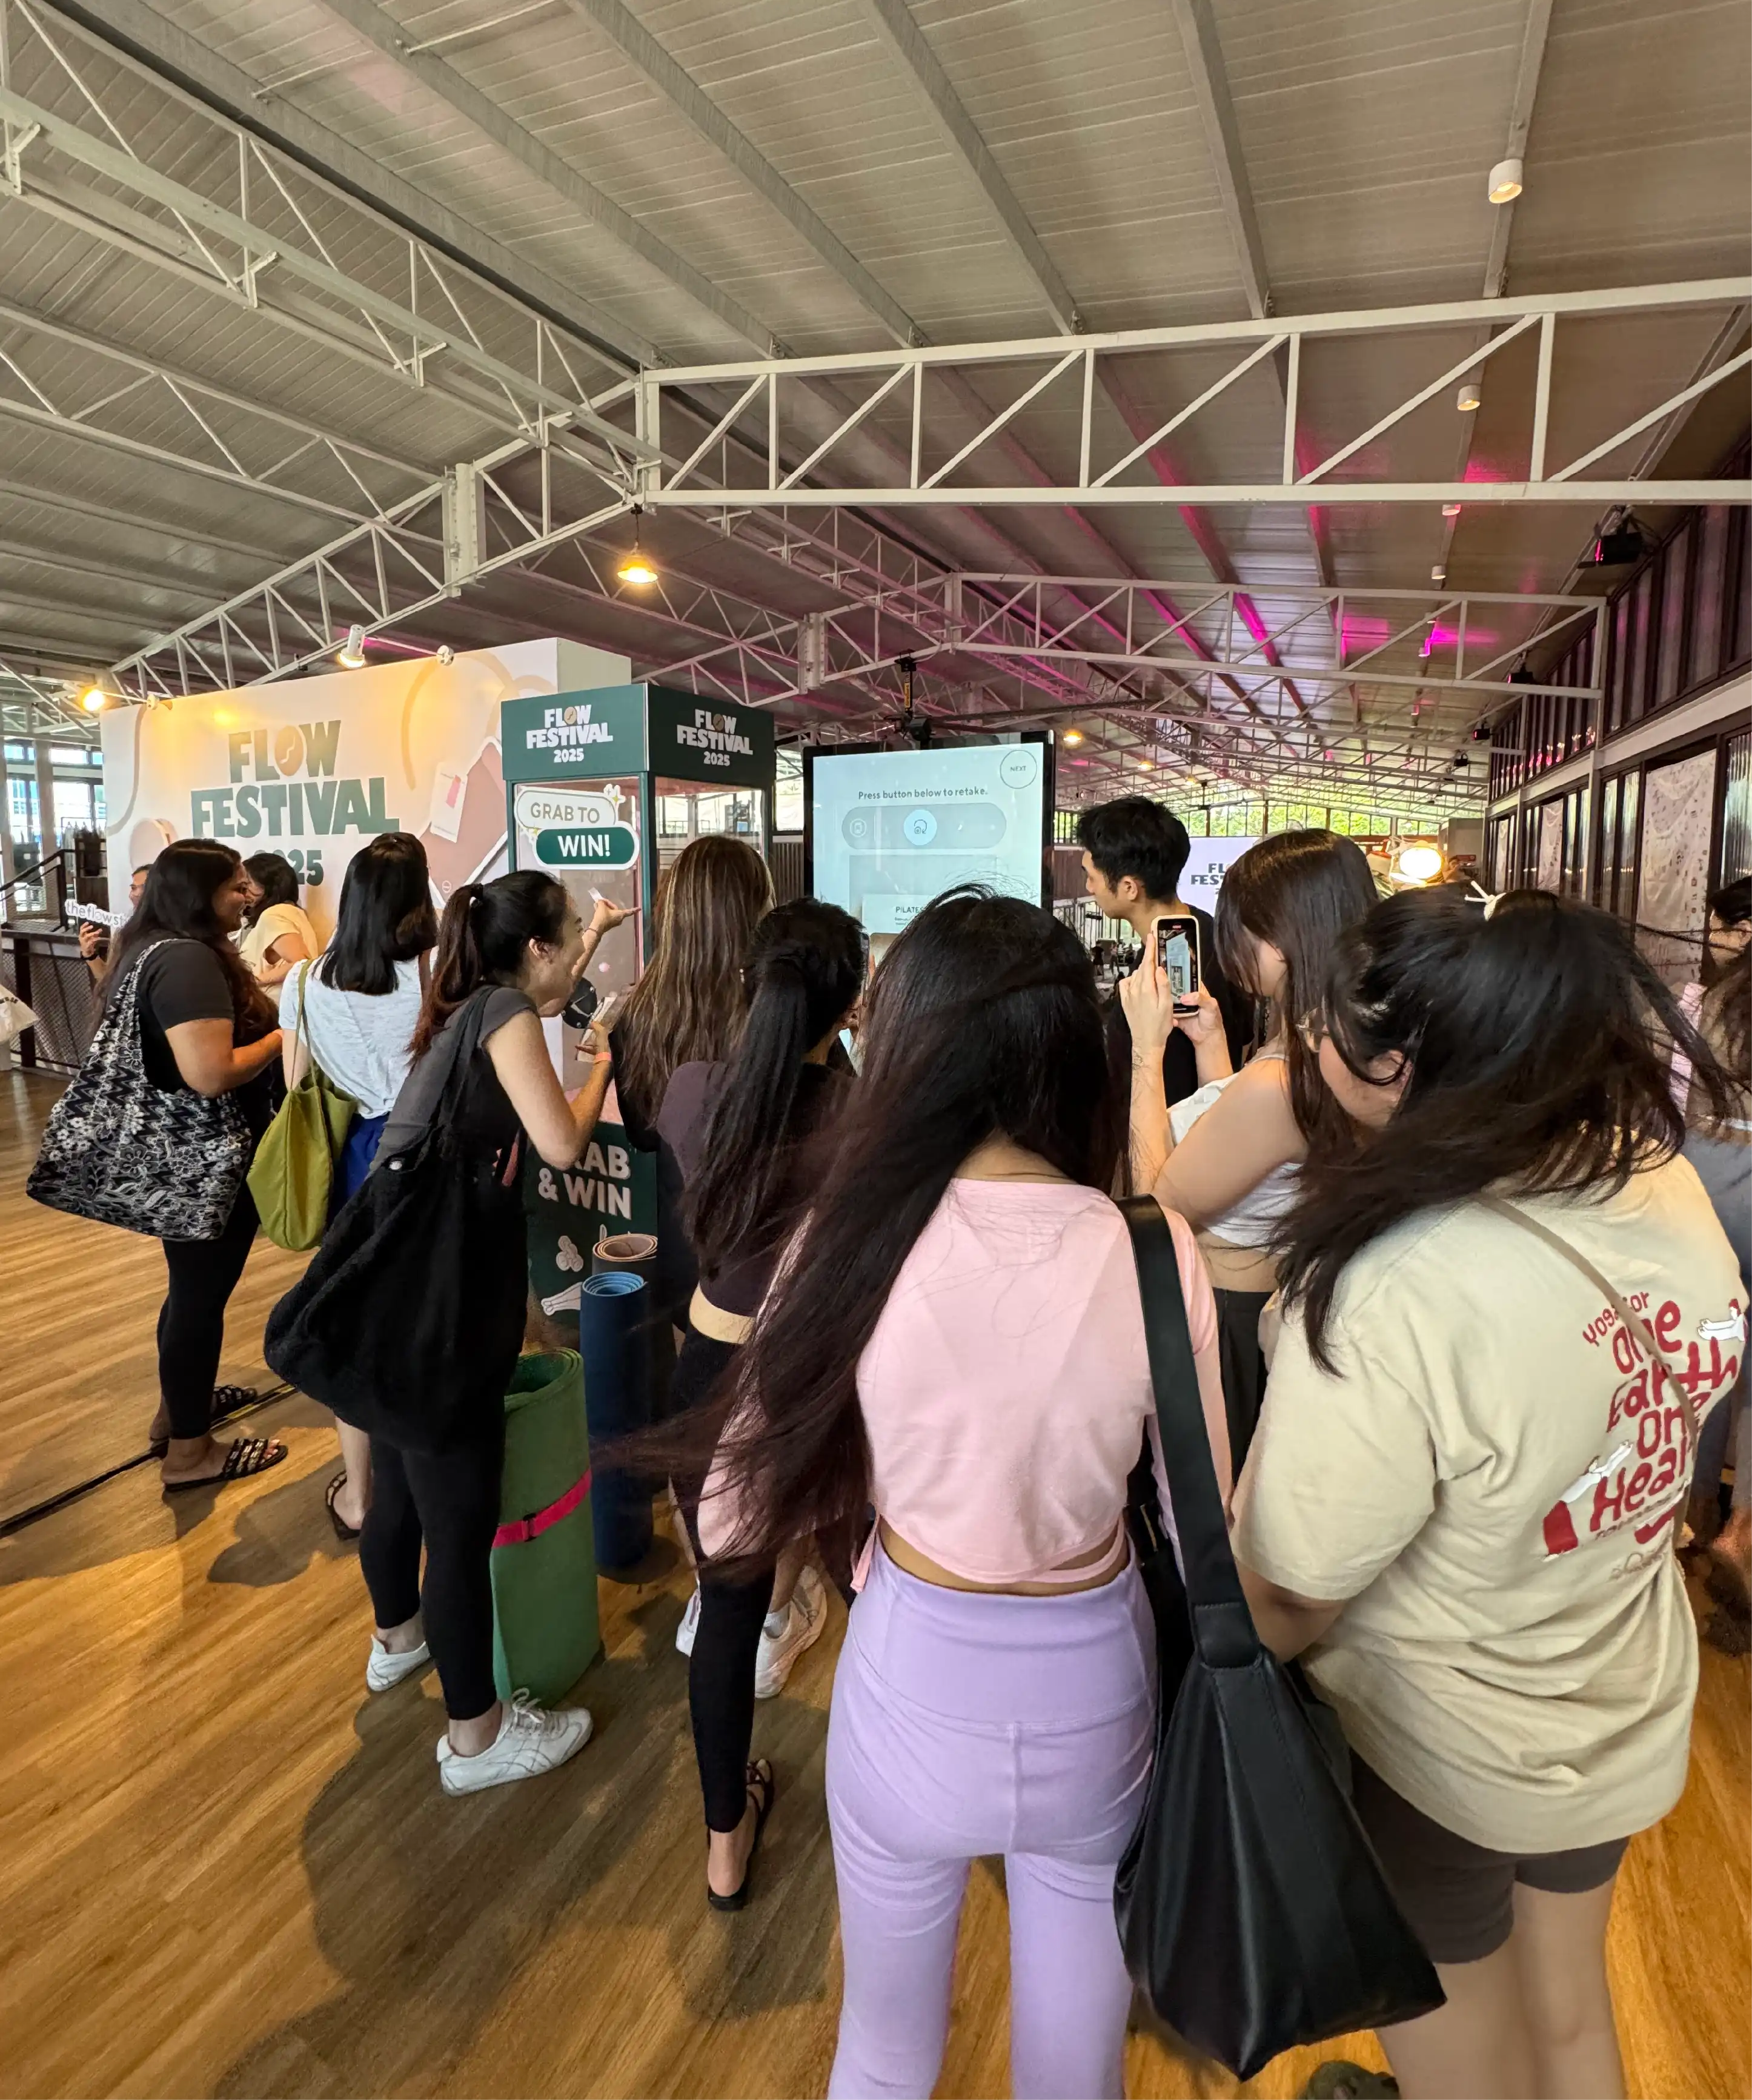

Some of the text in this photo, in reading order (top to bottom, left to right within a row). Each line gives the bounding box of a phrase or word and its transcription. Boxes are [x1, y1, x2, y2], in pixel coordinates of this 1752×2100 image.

[545, 704, 592, 727] FLOW
[695, 709, 737, 735] FLOW
[526, 723, 613, 749] FESTIVAL
[677, 724, 753, 755] FESTIVAL
[228, 720, 341, 783] FLOW
[554, 748, 584, 763] 2025
[703, 751, 731, 766] 2025
[858, 790, 880, 800] Press
[883, 790, 912, 799] button
[914, 788, 941, 797] below
[955, 786, 988, 796] retake.
[191, 777, 400, 838] FESTIVAL
[531, 802, 600, 824] GRAB TO
[557, 834, 611, 857] WIN!
[1208, 863, 1229, 873] FL
[575, 1142, 631, 1180] AB
[538, 1168, 631, 1220] & WIN
[1590, 1433, 1694, 1532] Heal
